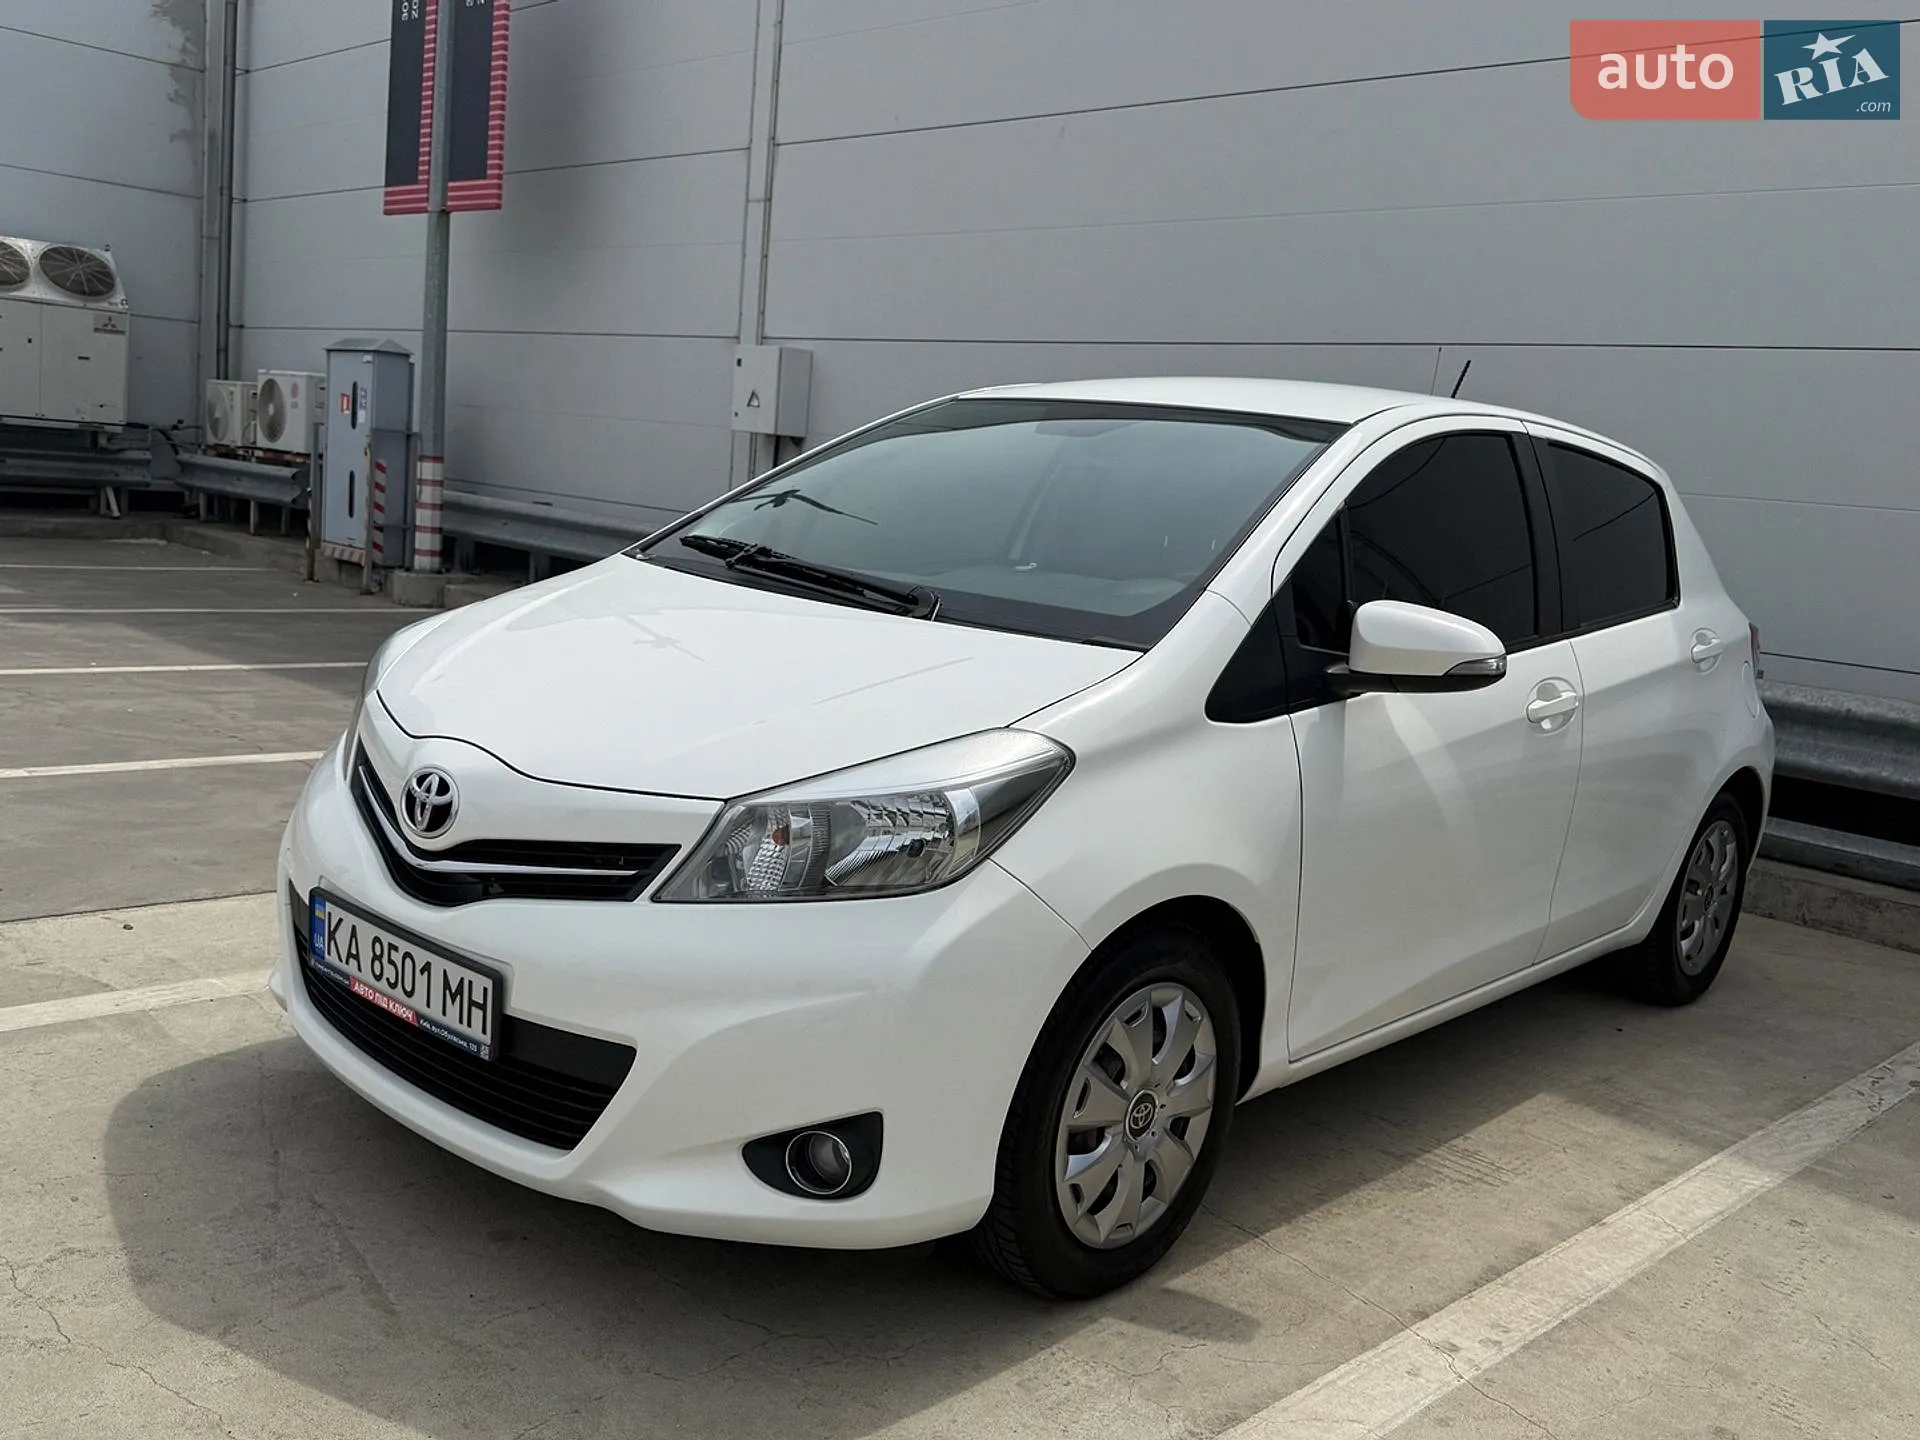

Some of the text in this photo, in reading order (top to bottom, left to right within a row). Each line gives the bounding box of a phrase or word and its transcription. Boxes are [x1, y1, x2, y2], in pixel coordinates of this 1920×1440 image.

[314, 932, 324, 951] UA
[327, 911, 489, 1036] KA 8501 MH
[353, 981, 374, 1001] АВТО
[388, 1000, 414, 1021] КЛЮЧ
